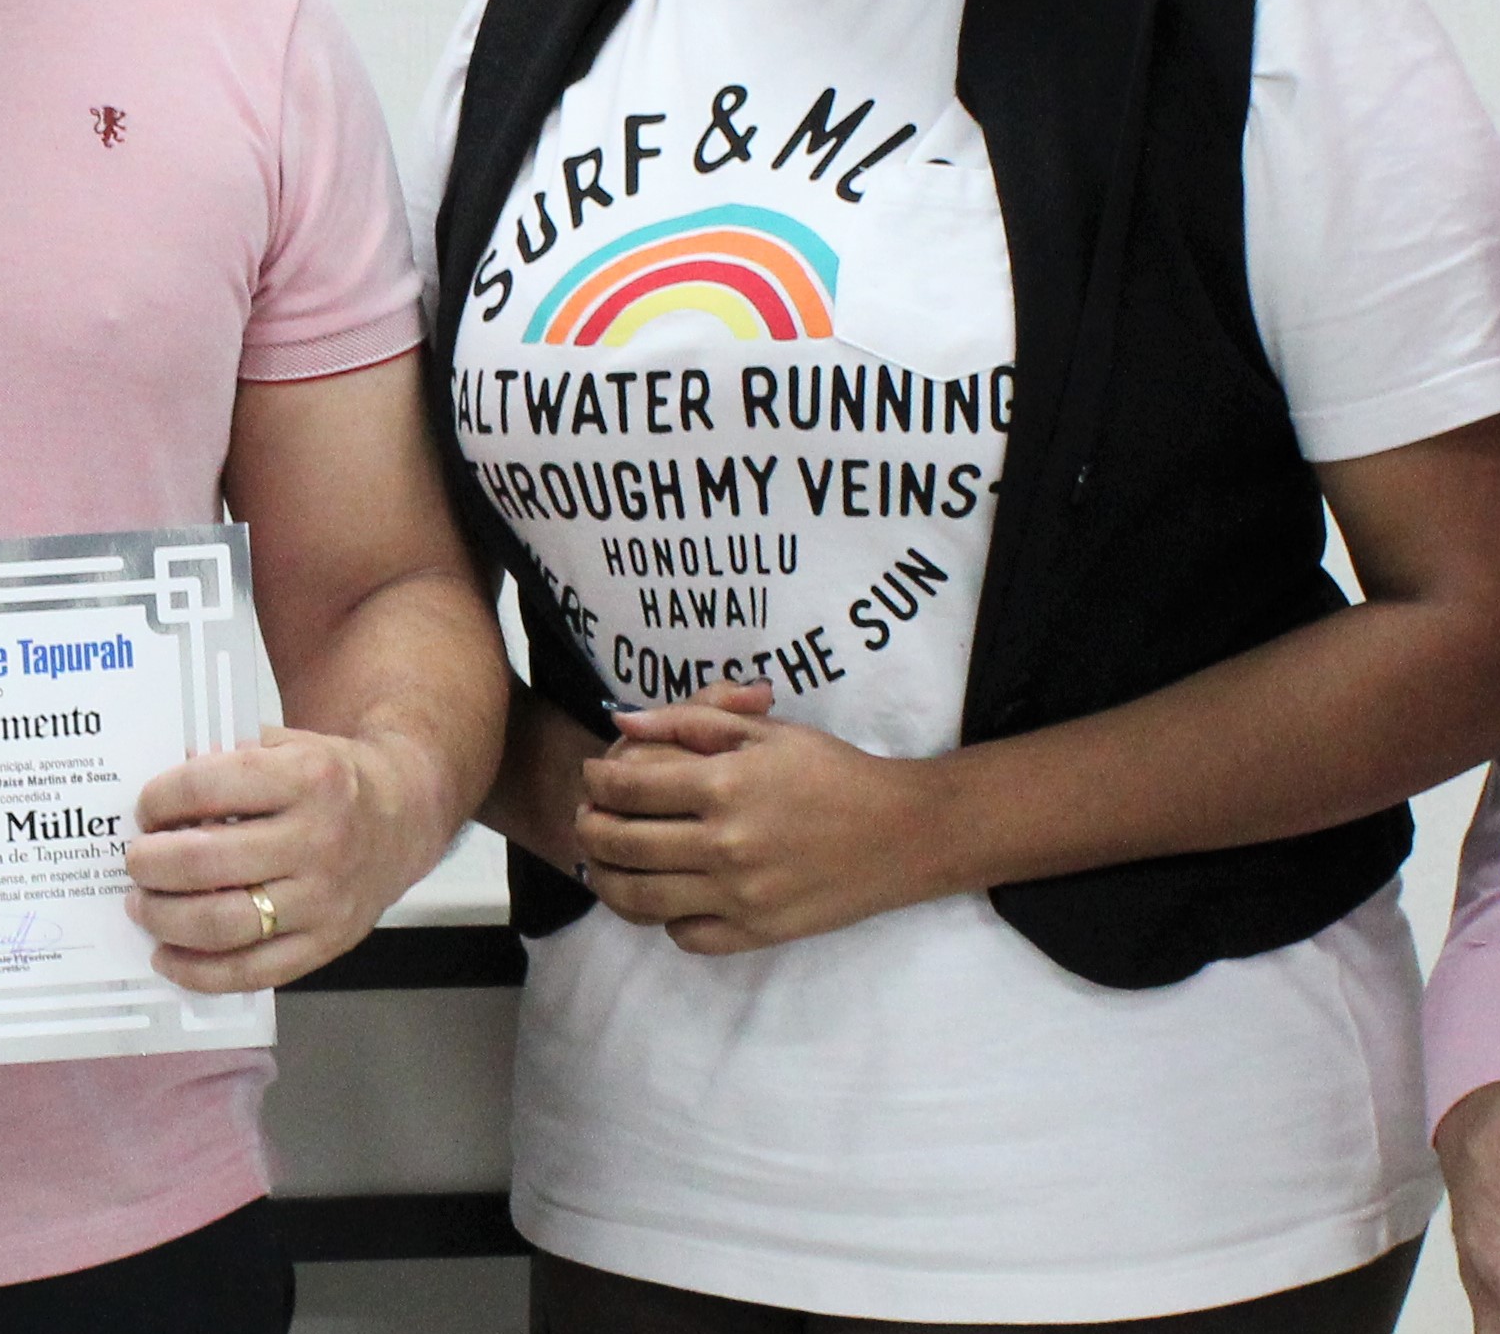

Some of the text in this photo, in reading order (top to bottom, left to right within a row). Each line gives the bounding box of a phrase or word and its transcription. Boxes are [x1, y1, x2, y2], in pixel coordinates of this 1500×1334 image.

[473, 113, 666, 322] SURF
[693, 84, 757, 174] &
[451, 365, 1015, 434] ALTWATER RUNNING
[476, 458, 685, 521] HROUGH
[696, 456, 777, 518] MY
[602, 533, 797, 577] HONOLULU
[639, 586, 767, 629] HAWAII
[752, 626, 845, 695] THE
[849, 547, 949, 651] SUN
[17, 634, 133, 679] Tapurah
[27, 775, 67, 786] Martins
[71, 773, 83, 784] de
[6, 808, 120, 842] Müller
[9, 848, 28, 864] de
[33, 840, 132, 867] Tapurah-M
